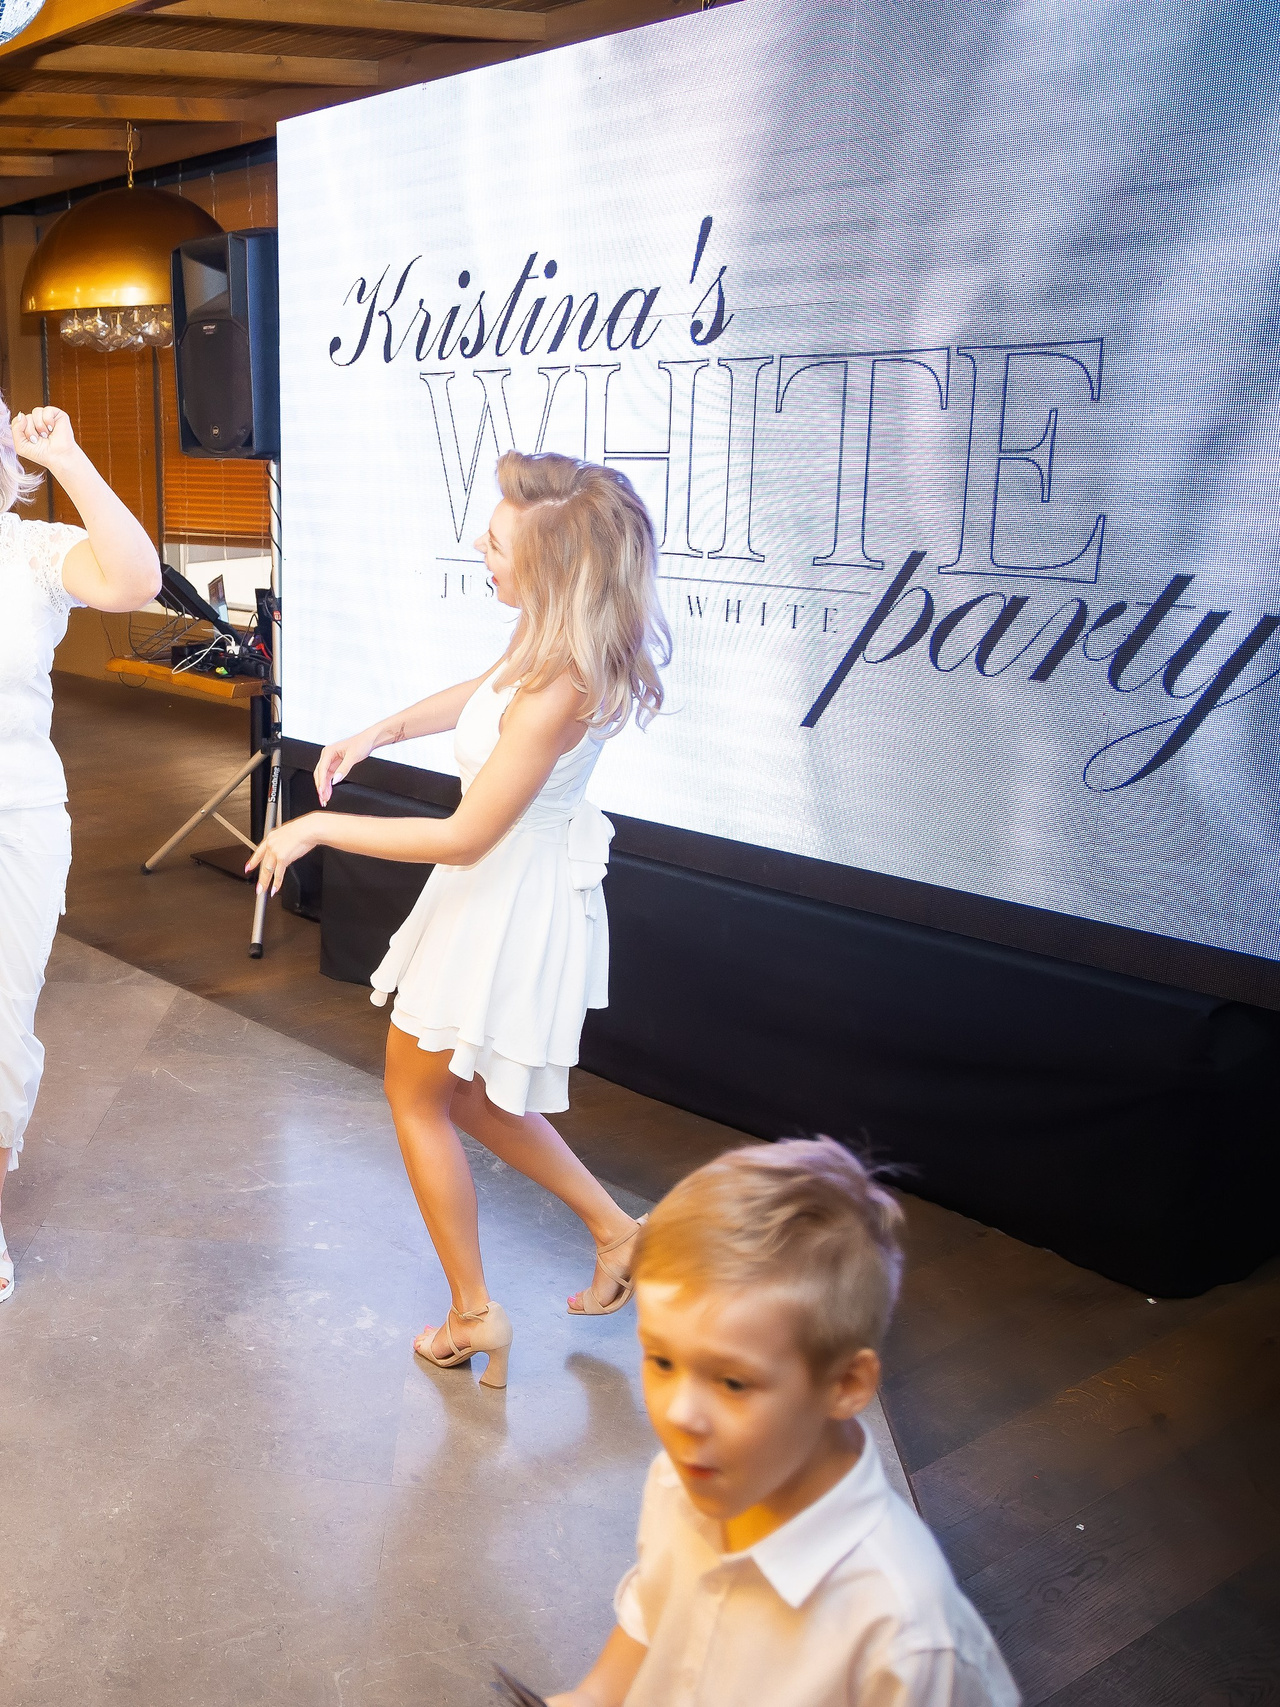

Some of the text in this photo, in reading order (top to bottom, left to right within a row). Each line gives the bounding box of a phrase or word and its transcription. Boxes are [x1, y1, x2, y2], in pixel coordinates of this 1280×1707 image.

[329, 215, 735, 366] Kristina's
[421, 338, 1106, 584] WHITE
[441, 573, 839, 633] JUS WHITE
[800, 550, 1280, 792] party
